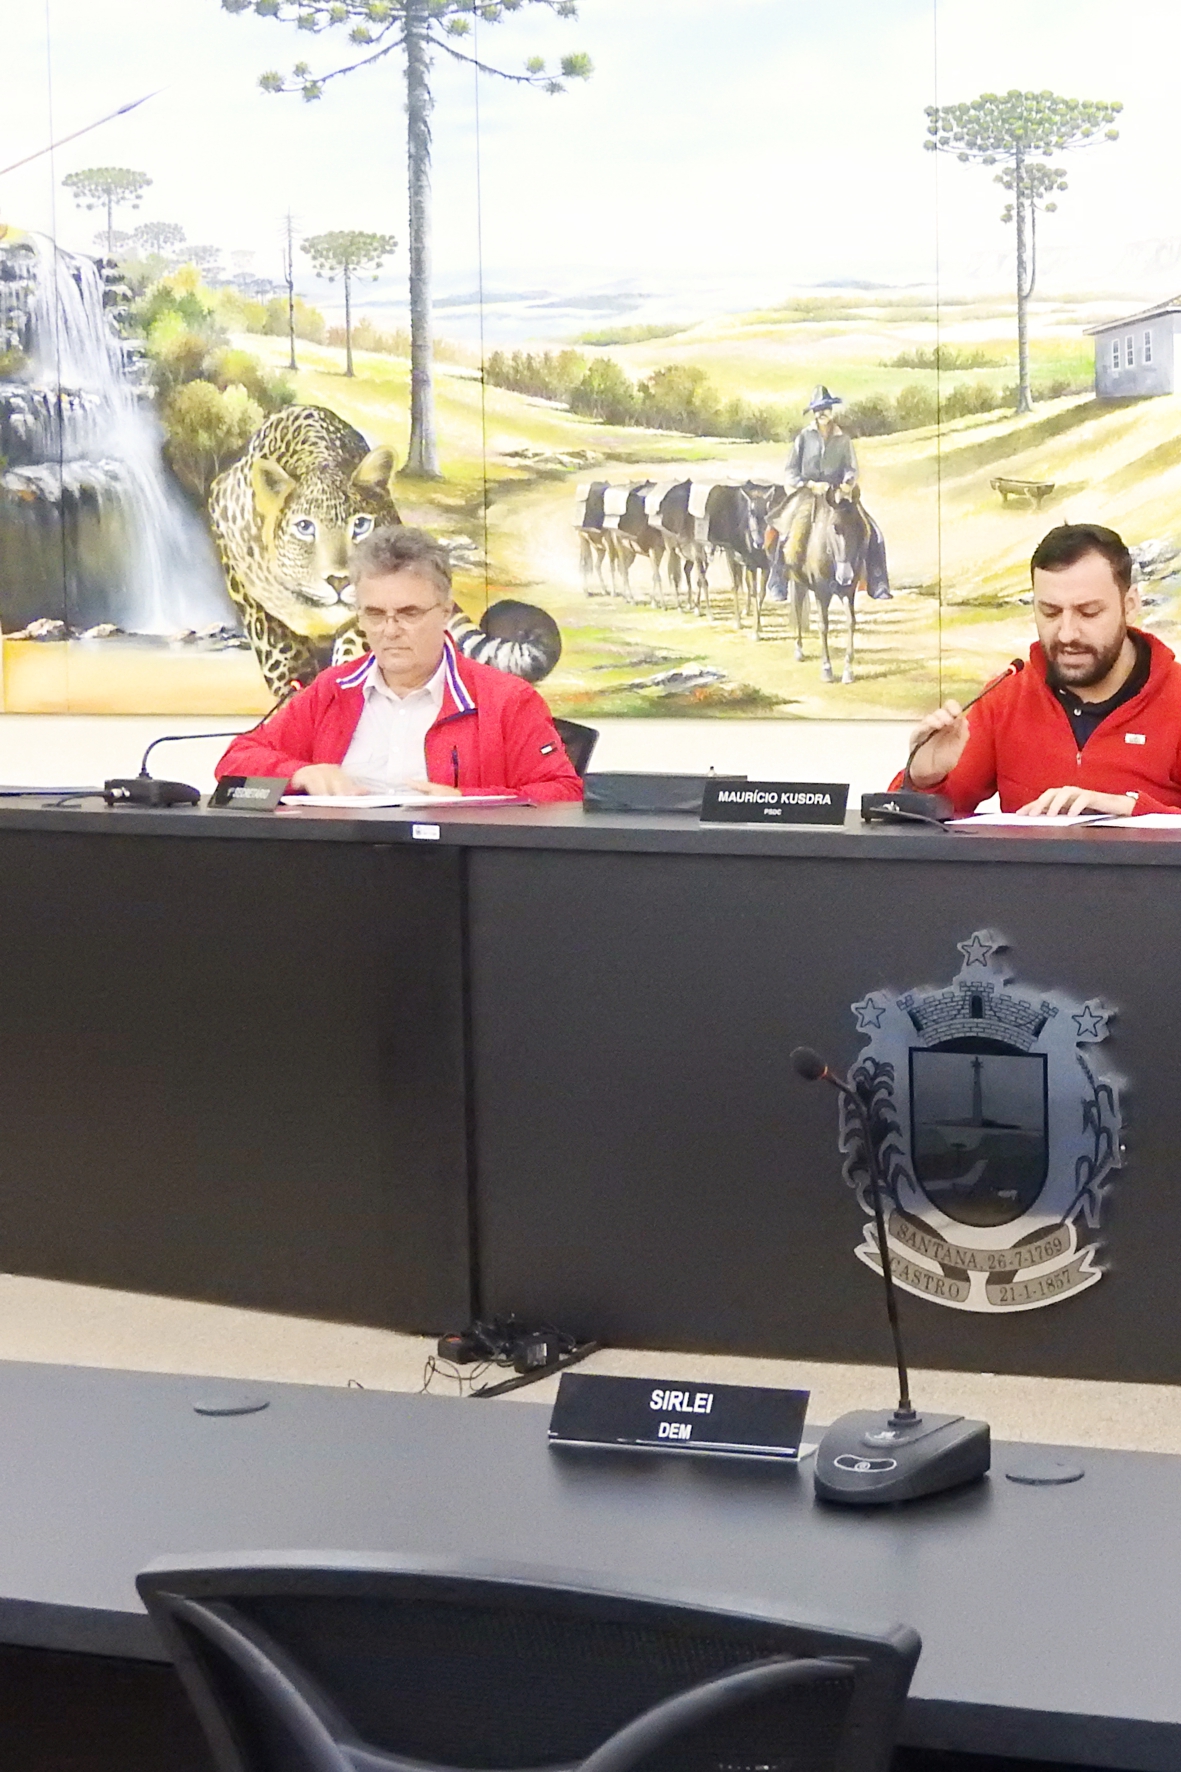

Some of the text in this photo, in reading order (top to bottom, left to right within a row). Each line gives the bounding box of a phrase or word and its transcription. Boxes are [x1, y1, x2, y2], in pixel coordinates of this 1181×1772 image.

[718, 789, 832, 805] MAURÍCIO KUSDRA
[888, 1257, 960, 1298] CASTRO
[649, 1389, 714, 1414] SIRLEI
[658, 1421, 692, 1441] DEM
